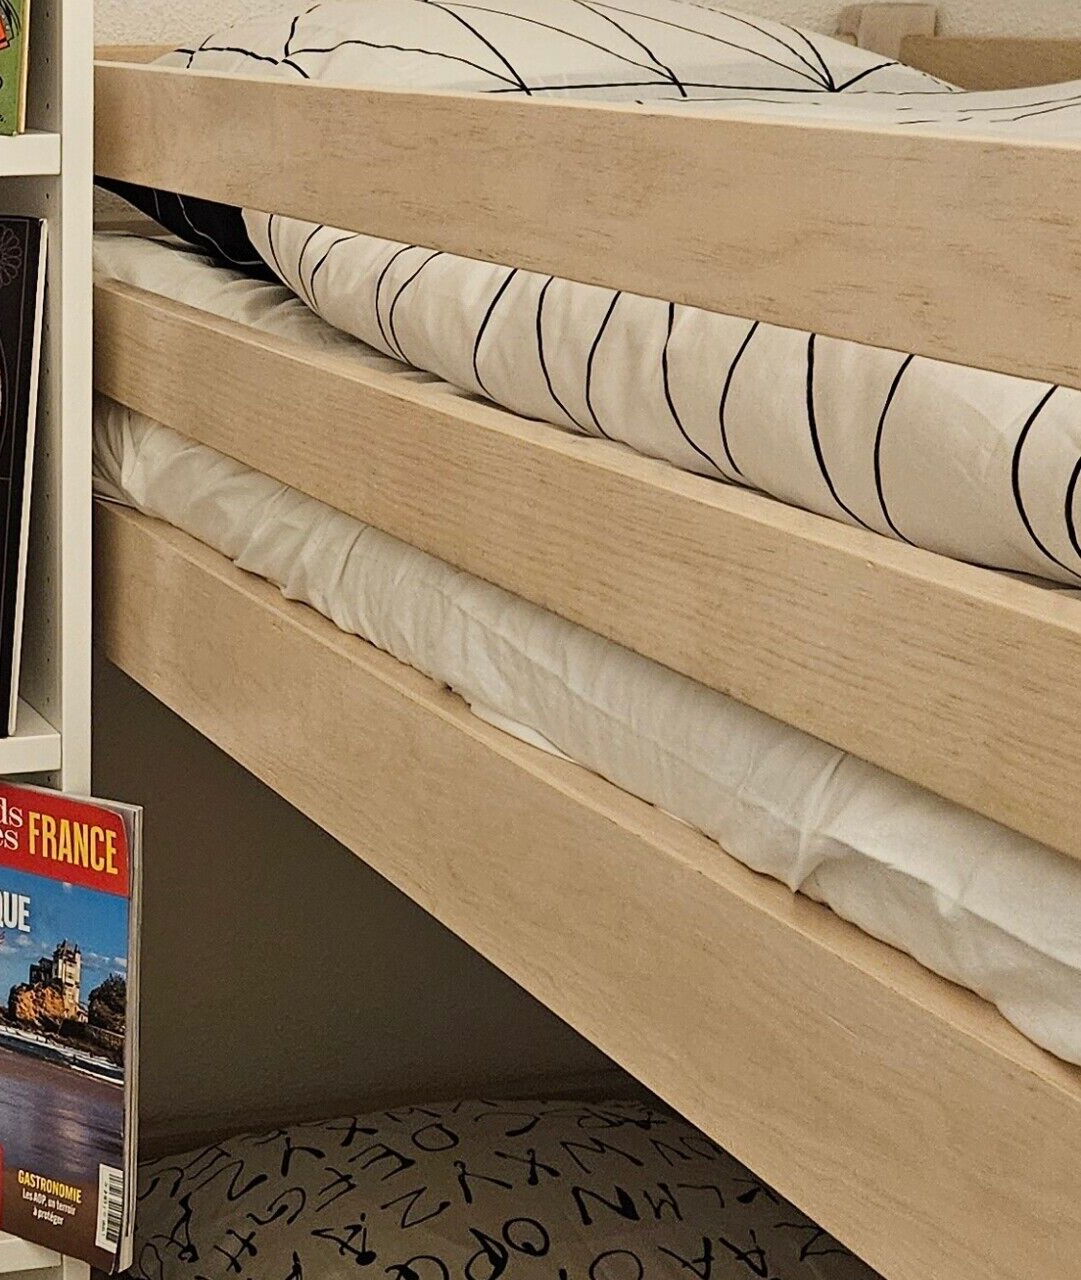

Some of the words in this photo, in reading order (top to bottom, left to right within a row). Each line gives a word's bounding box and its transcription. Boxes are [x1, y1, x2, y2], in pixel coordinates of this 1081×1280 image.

[28, 811, 119, 875] FRANCE
[18, 1169, 82, 1204] GASTRONOMIE
[22, 1187, 34, 1202] Les
[38, 1208, 64, 1226] protéger
